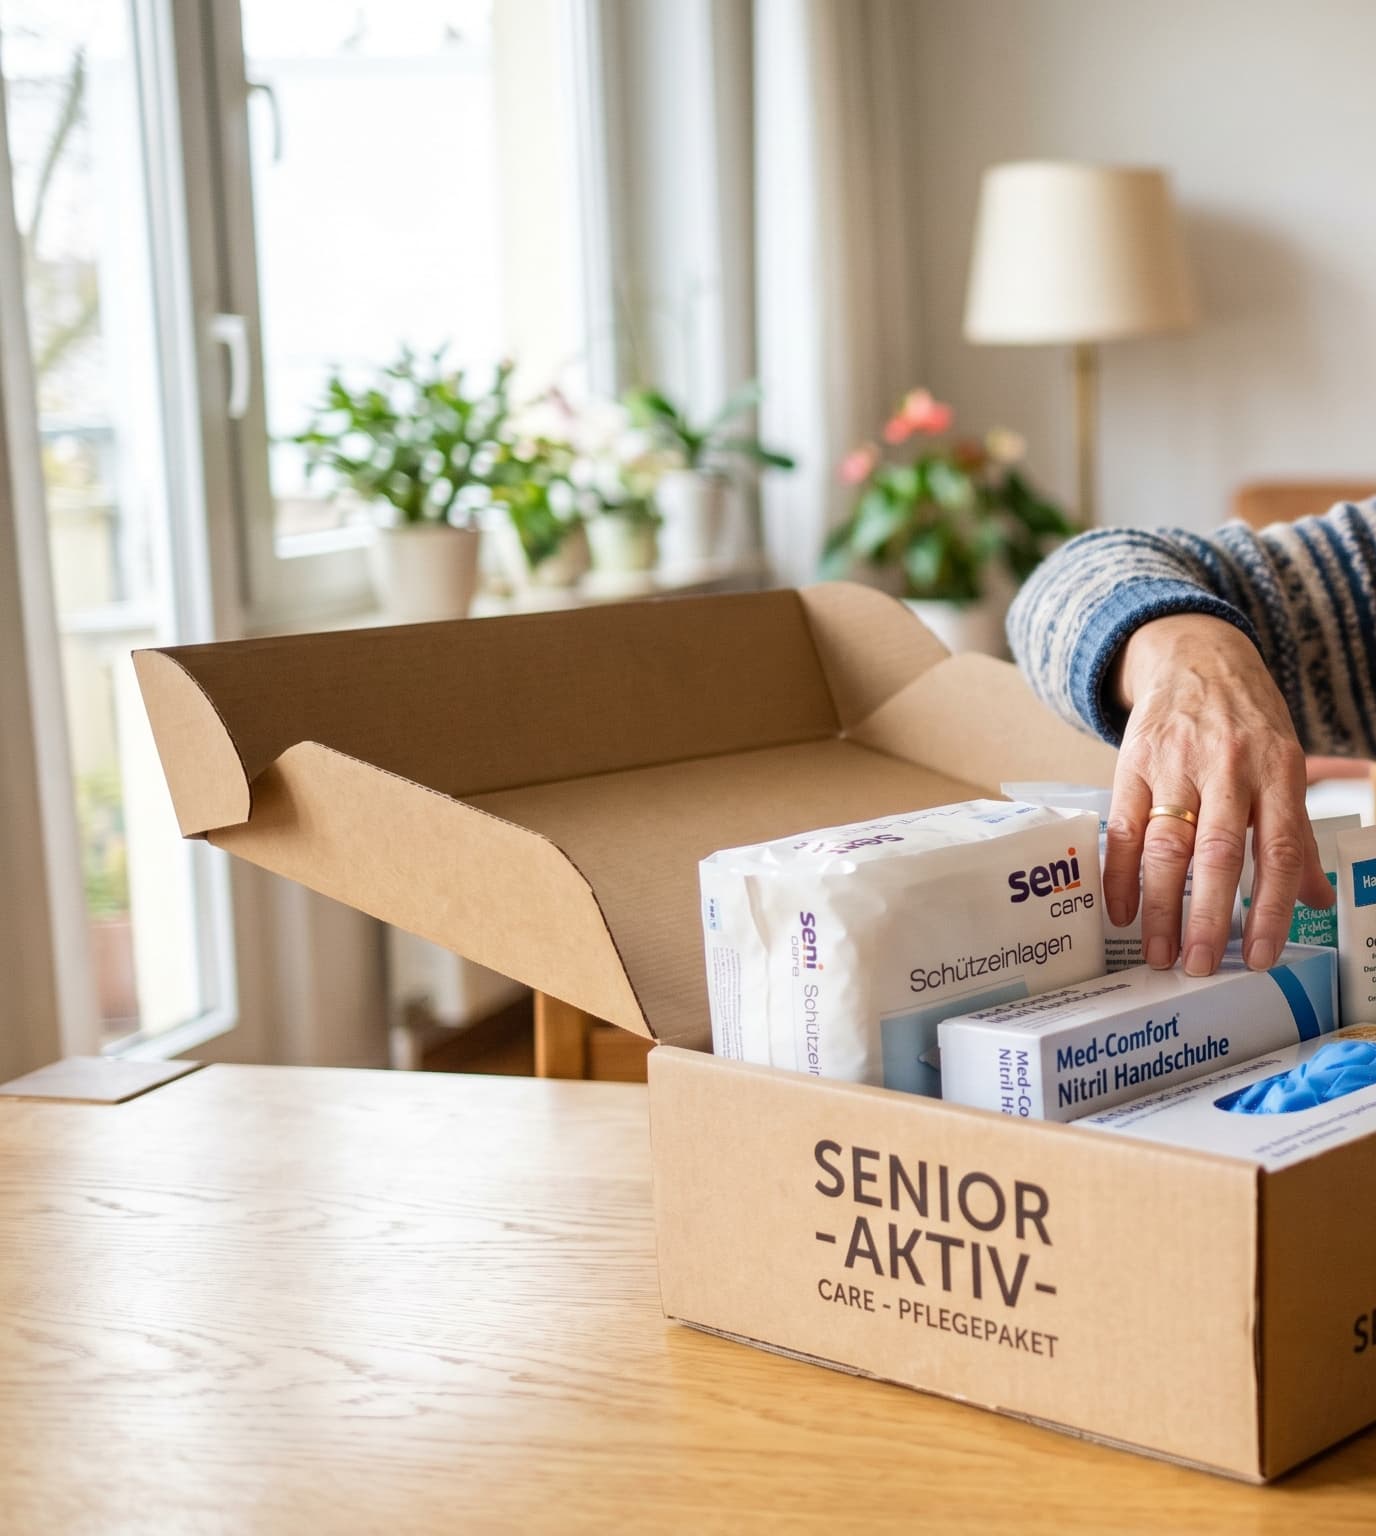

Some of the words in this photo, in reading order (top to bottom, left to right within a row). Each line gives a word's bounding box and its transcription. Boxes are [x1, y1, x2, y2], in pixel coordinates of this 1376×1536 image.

[1008, 847, 1081, 904] seni
[1050, 892, 1094, 918] care
[800, 911, 824, 970] seni
[909, 932, 1073, 993] Schützeinlagen
[999, 1048, 1014, 1091] Nitril
[1056, 1015, 1180, 1073] Med-Comfort
[1058, 1074, 1108, 1109] Nitril
[1114, 1035, 1230, 1091] Handschuhe
[814, 1139, 1053, 1247] SENIOR
[817, 1278, 876, 1313] CARE
[899, 1297, 1059, 1359] PFLEGEPAKET
